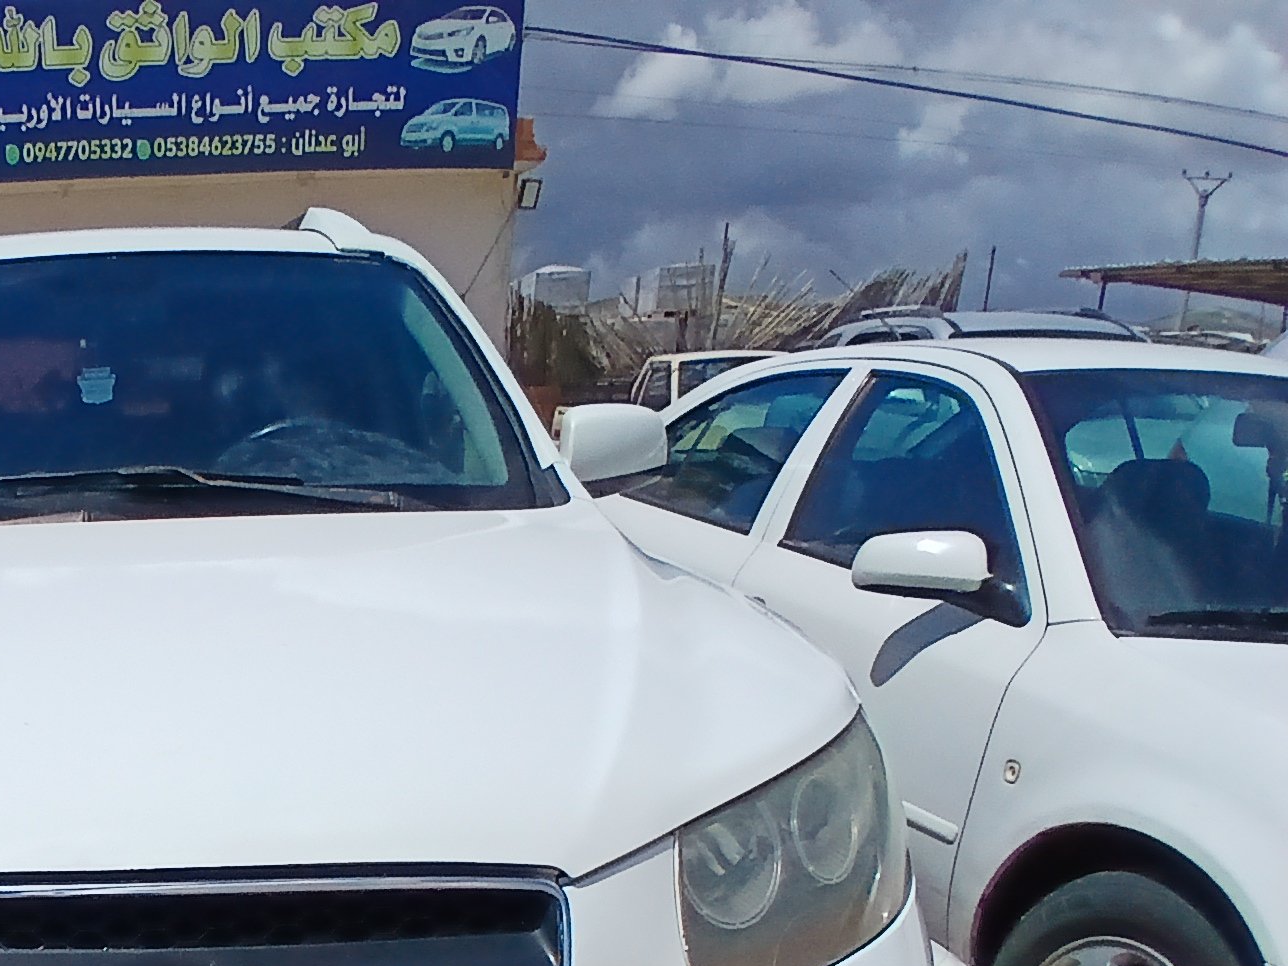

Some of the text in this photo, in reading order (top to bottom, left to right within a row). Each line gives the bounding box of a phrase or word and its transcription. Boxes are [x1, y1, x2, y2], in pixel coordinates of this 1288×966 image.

[99, 0, 260, 81] الواثق
[268, 2, 401, 76] مكتب
[76, 93, 187, 126] السيارات
[257, 92, 321, 124] جميع
[326, 85, 407, 118] لتجارة
[23, 138, 133, 163] 0947705332
[153, 133, 276, 158] 05384623755
[291, 128, 337, 156] عدنان
